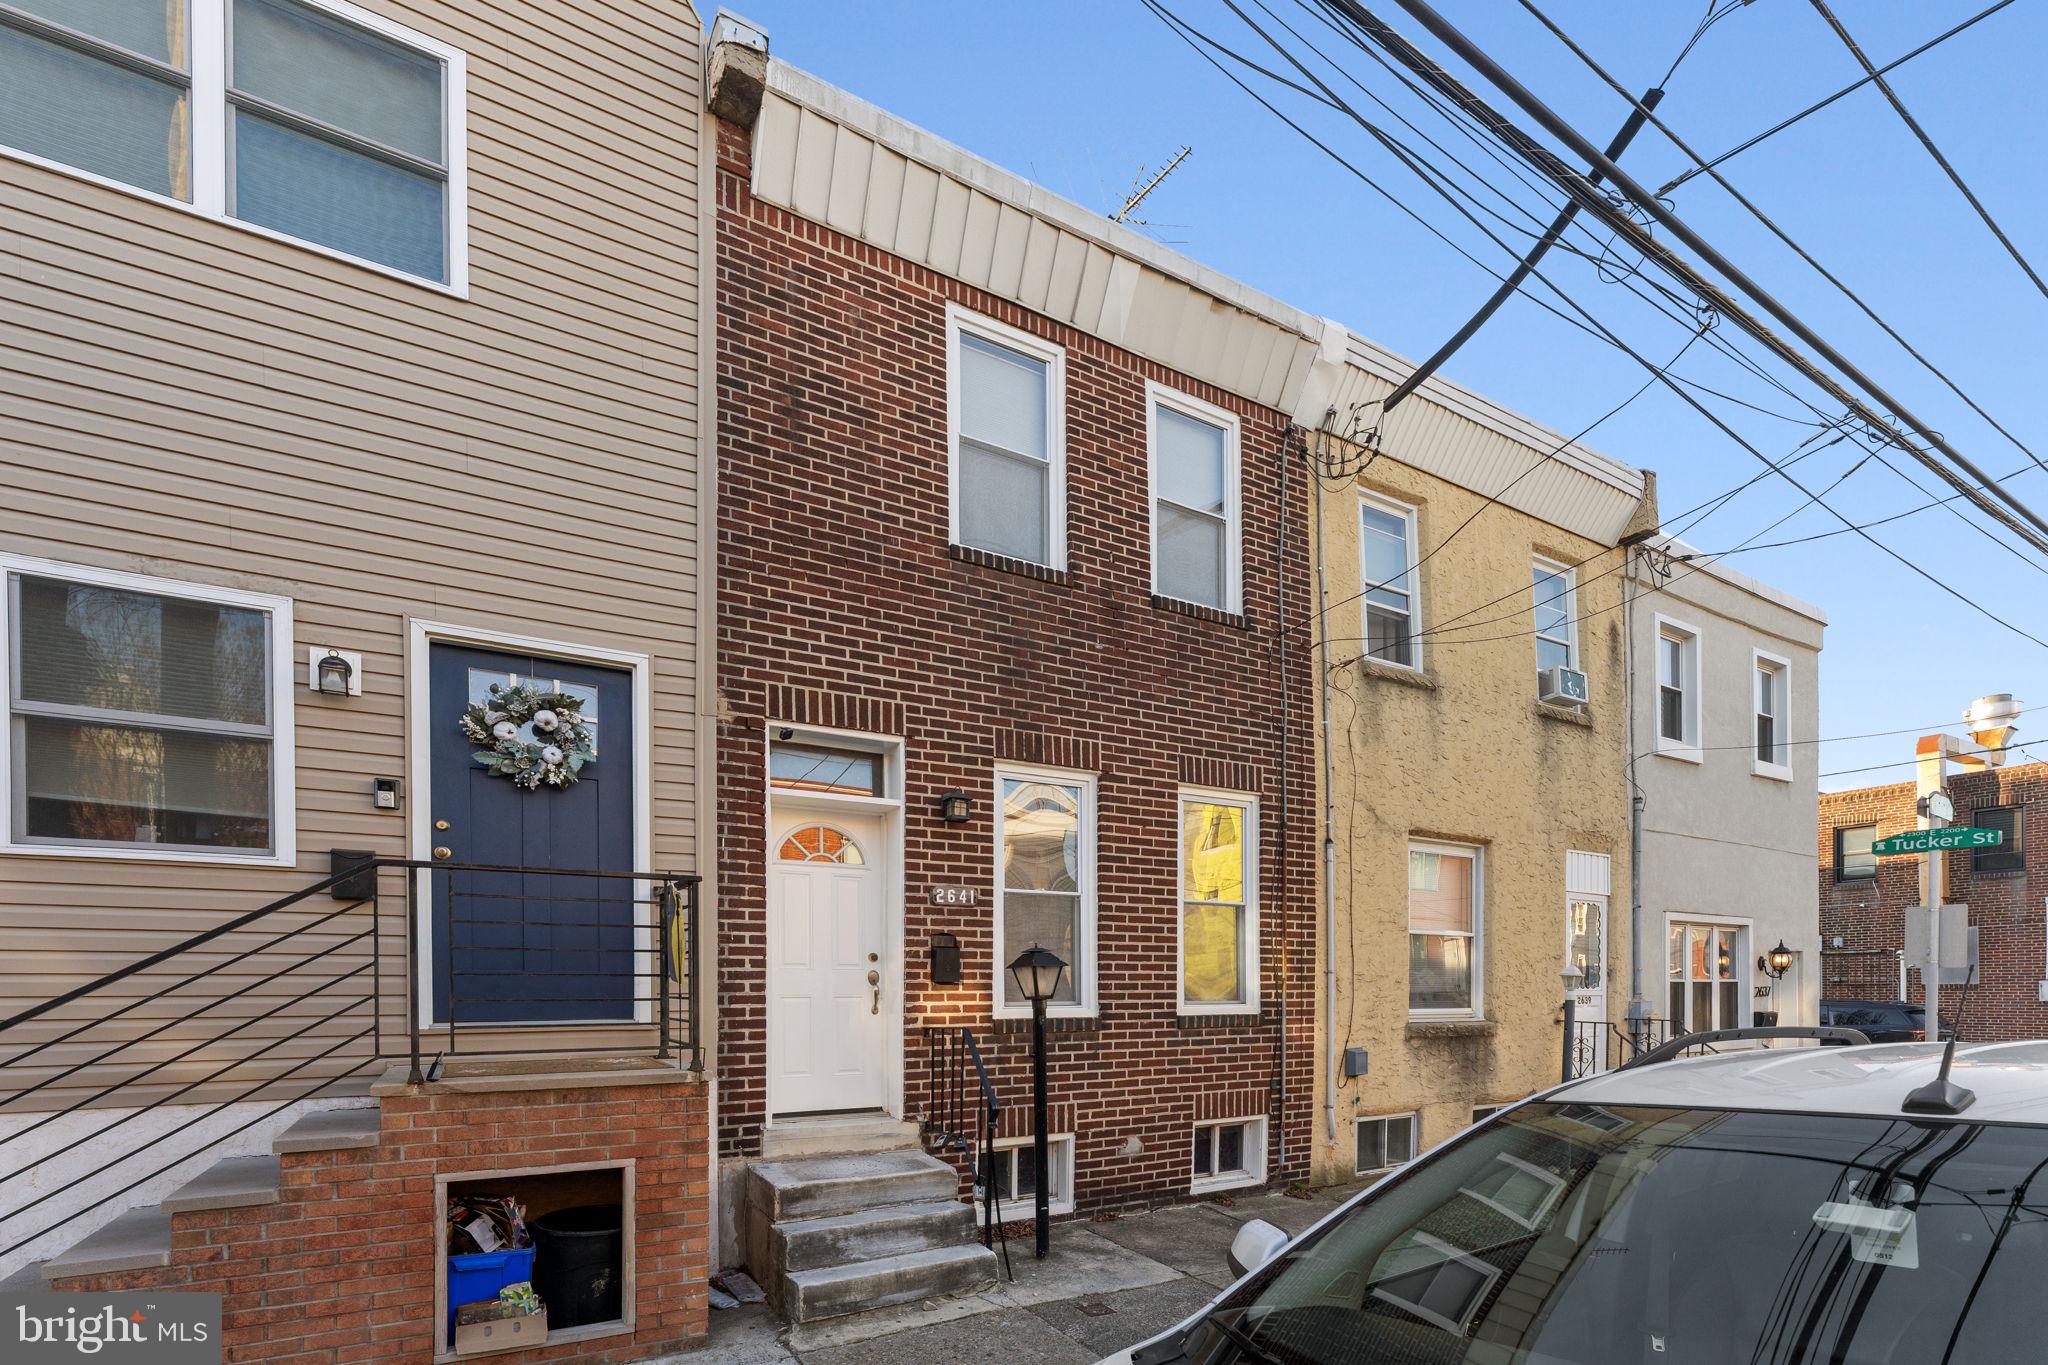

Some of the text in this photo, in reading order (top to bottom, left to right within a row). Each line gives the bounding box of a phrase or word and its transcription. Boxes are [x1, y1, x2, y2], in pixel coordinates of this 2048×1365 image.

[1891, 832, 1994, 851] Tucker St
[936, 888, 974, 904] 2641
